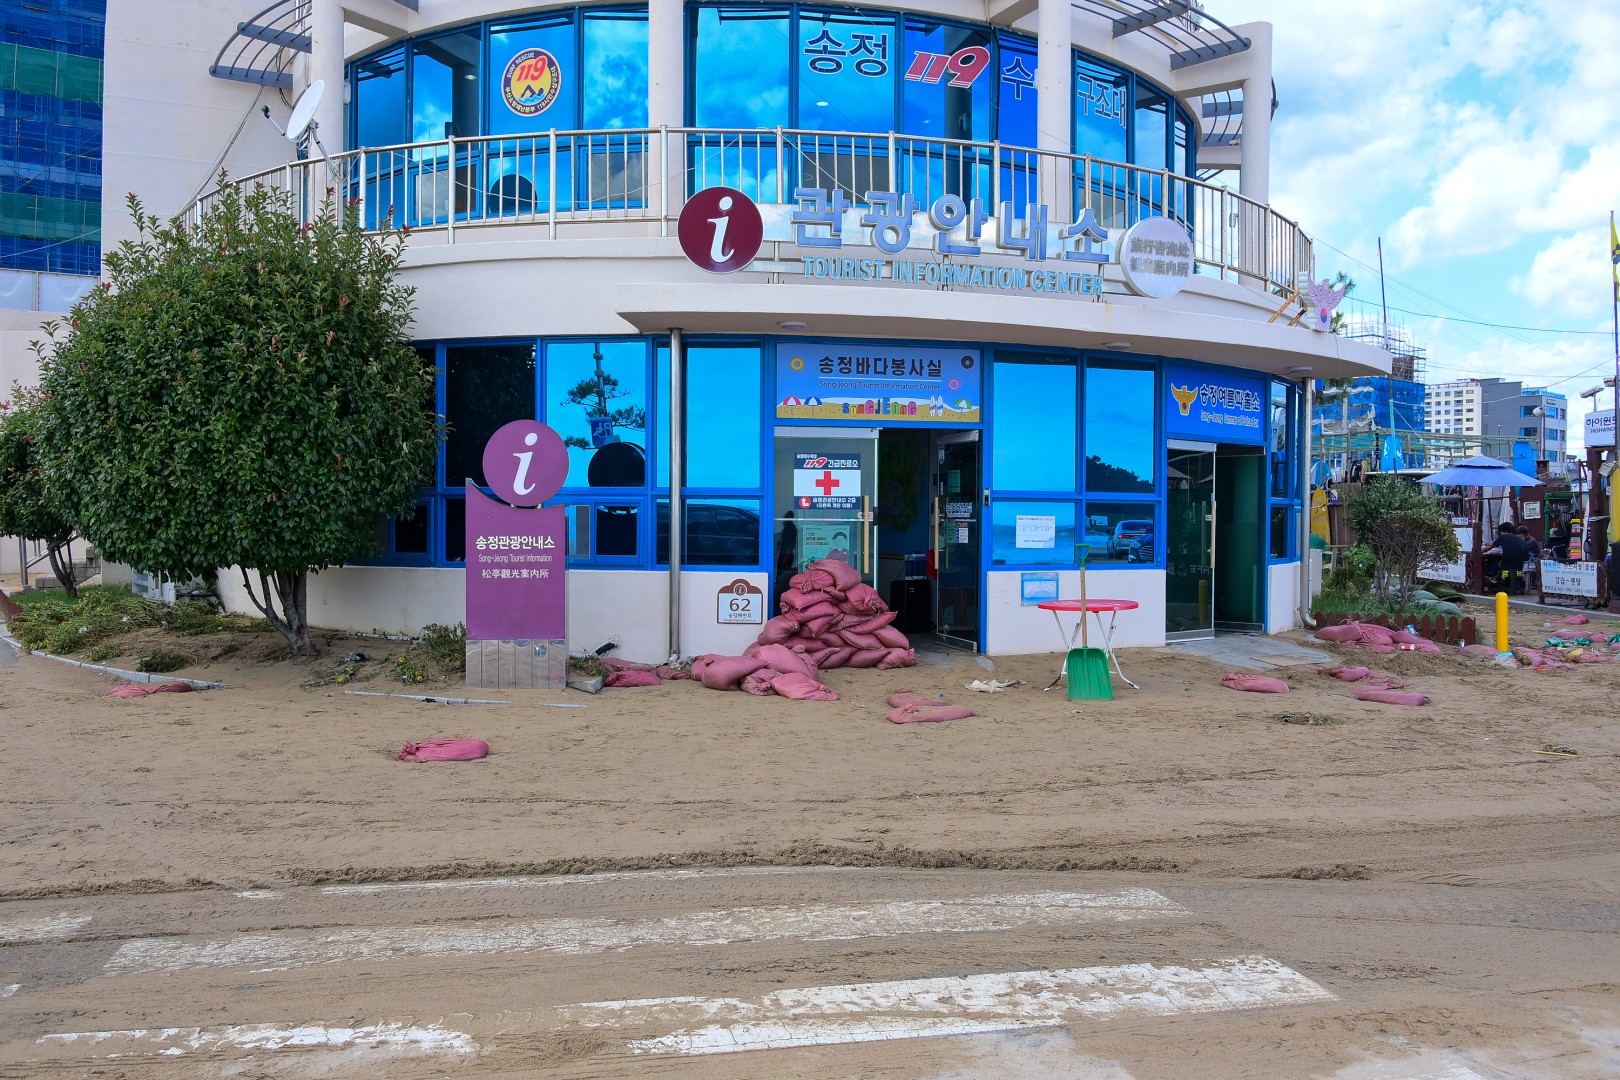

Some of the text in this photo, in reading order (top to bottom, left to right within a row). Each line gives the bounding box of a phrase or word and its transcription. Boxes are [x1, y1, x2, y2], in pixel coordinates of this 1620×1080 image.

[517, 55, 548, 81] 119
[803, 26, 889, 77] 송정
[904, 45, 991, 88] 119
[791, 186, 1110, 263] 관광안내소
[1130, 236, 1190, 258] 旅行咨询处
[801, 256, 1104, 296] TOURIST INFORMATION CENTER
[818, 355, 942, 378] 송정바다봉사실
[858, 381, 880, 389] Tourist
[881, 382, 918, 390] Information
[920, 383, 940, 391] Center
[1200, 384, 1260, 412] 송정여름파출소
[803, 457, 827, 468] 119
[475, 535, 556, 549] 송정관광안내소
[509, 553, 525, 562] Tourist
[526, 554, 552, 563] Information
[729, 598, 751, 611] 62
